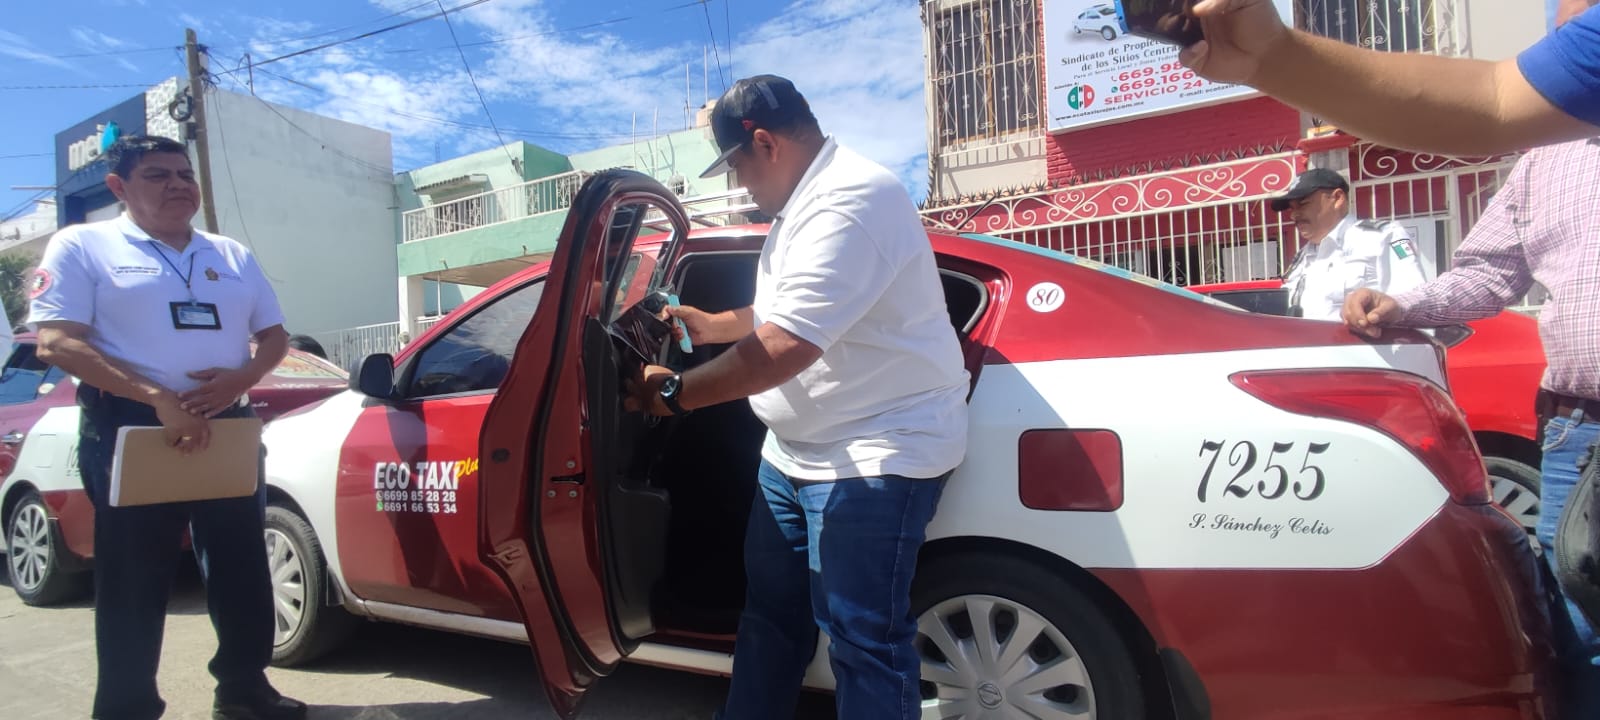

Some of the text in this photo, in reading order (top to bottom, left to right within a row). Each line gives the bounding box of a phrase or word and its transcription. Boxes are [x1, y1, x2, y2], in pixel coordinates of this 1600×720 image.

[1061, 51, 1105, 66] Sindicato
[1108, 47, 1120, 56] de
[1081, 63, 1092, 72] de
[1096, 60, 1109, 69] los
[1112, 53, 1140, 65] Sitios
[1104, 79, 1202, 105] SERVICIO 24
[1032, 288, 1060, 306] 80
[374, 461, 411, 490] ECO
[416, 461, 460, 490] TAXI
[1197, 439, 1331, 503] 7255
[384, 490, 456, 502] 6699 85 28 28
[384, 502, 457, 514] 6691 66 53 34
[1189, 513, 1334, 539] S. Sánchez Celis
